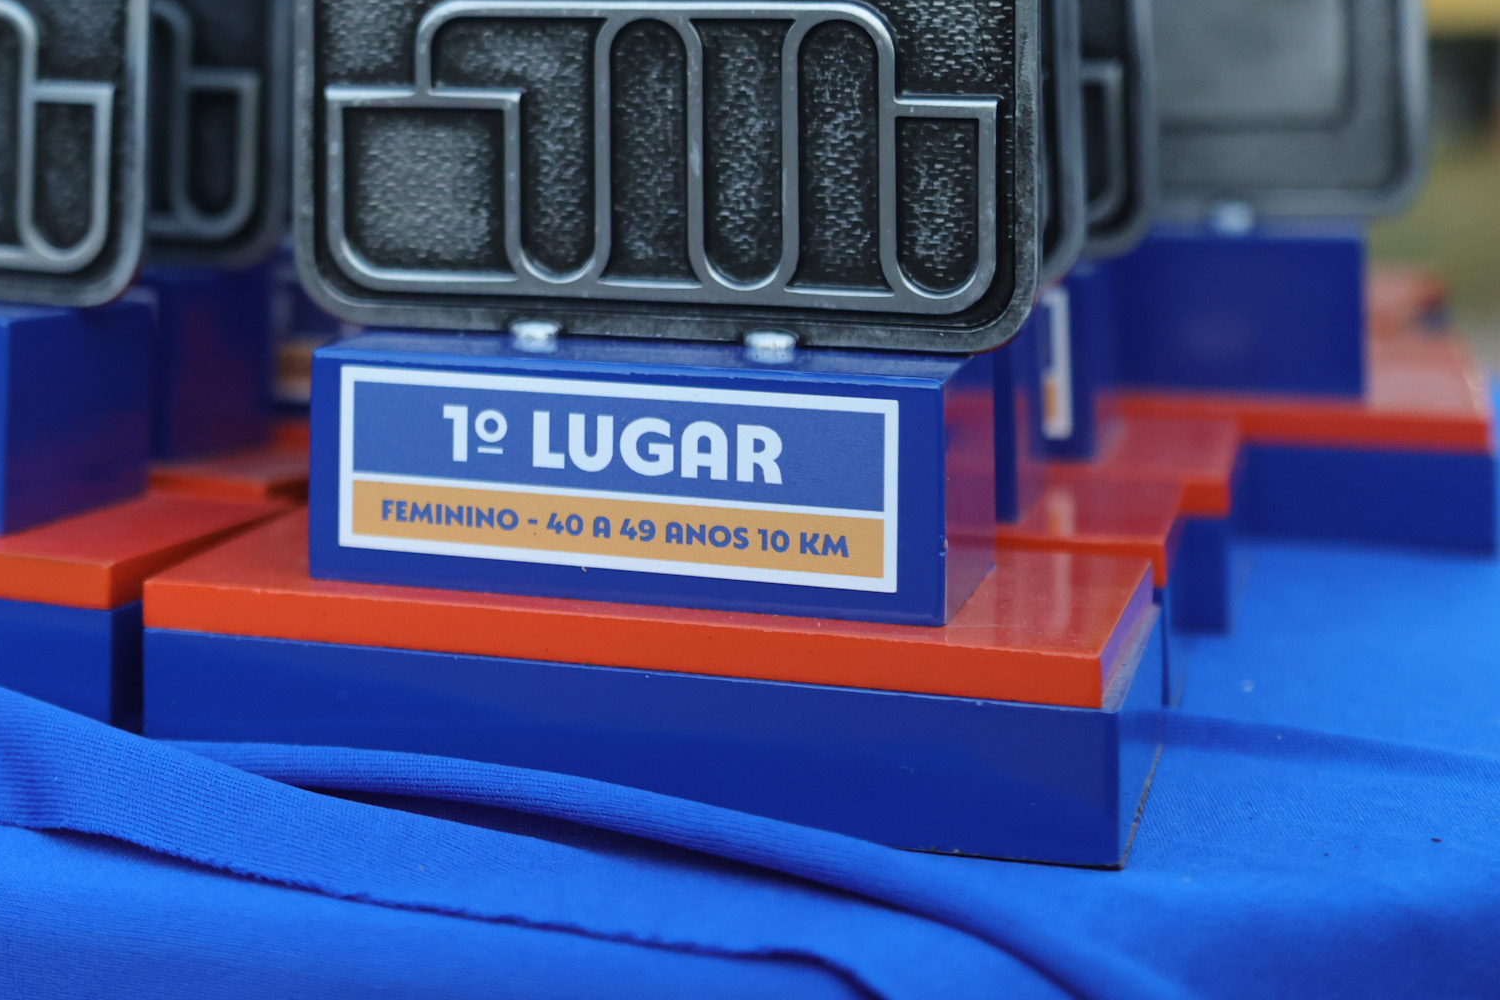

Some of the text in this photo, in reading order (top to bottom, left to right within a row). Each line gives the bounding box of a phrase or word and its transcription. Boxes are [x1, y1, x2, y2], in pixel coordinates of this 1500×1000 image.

[442, 403, 784, 486] 1º LUGAR
[381, 498, 519, 531] FEMININO
[546, 512, 584, 537] 40
[592, 514, 611, 540] A
[619, 517, 657, 543] 49
[665, 521, 750, 551] ANOS
[757, 526, 790, 554] 10
[799, 530, 850, 559] KM
